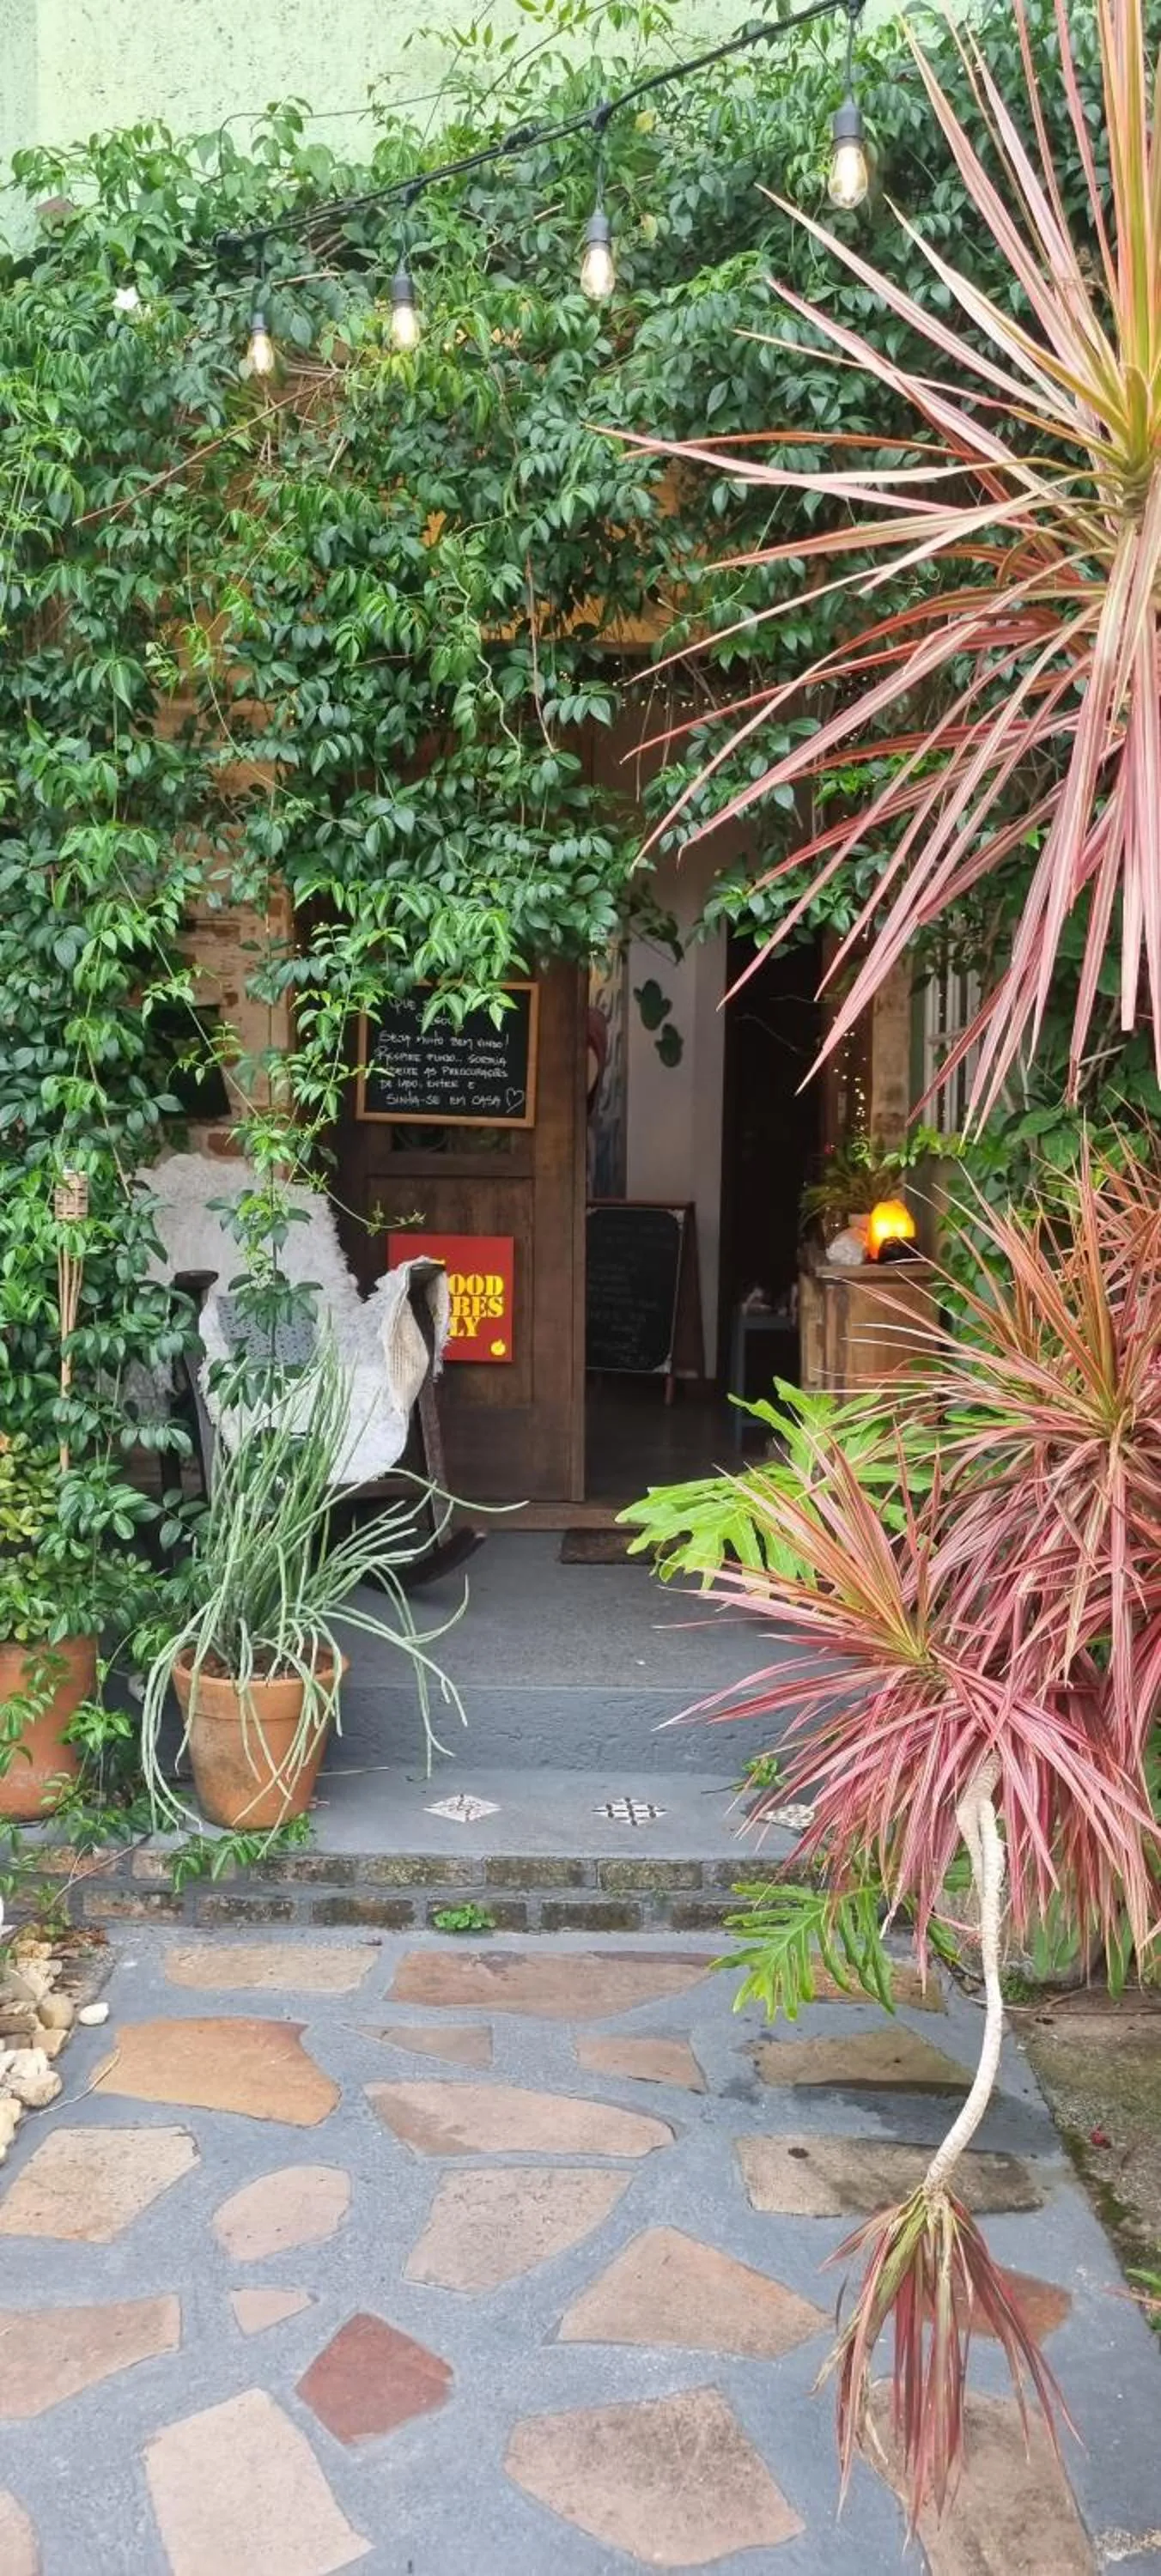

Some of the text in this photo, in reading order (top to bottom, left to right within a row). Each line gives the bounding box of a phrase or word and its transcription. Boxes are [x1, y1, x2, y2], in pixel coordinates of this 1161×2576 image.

[379, 1030, 410, 1048] SEJA
[450, 1037, 473, 1049] BEM
[423, 1066, 437, 1078] AS
[449, 1095, 466, 1105] EM
[471, 1095, 501, 1108] CASA
[447, 1273, 504, 1296] OOD
[450, 1296, 504, 1318] BES
[447, 1316, 482, 1337] LY
